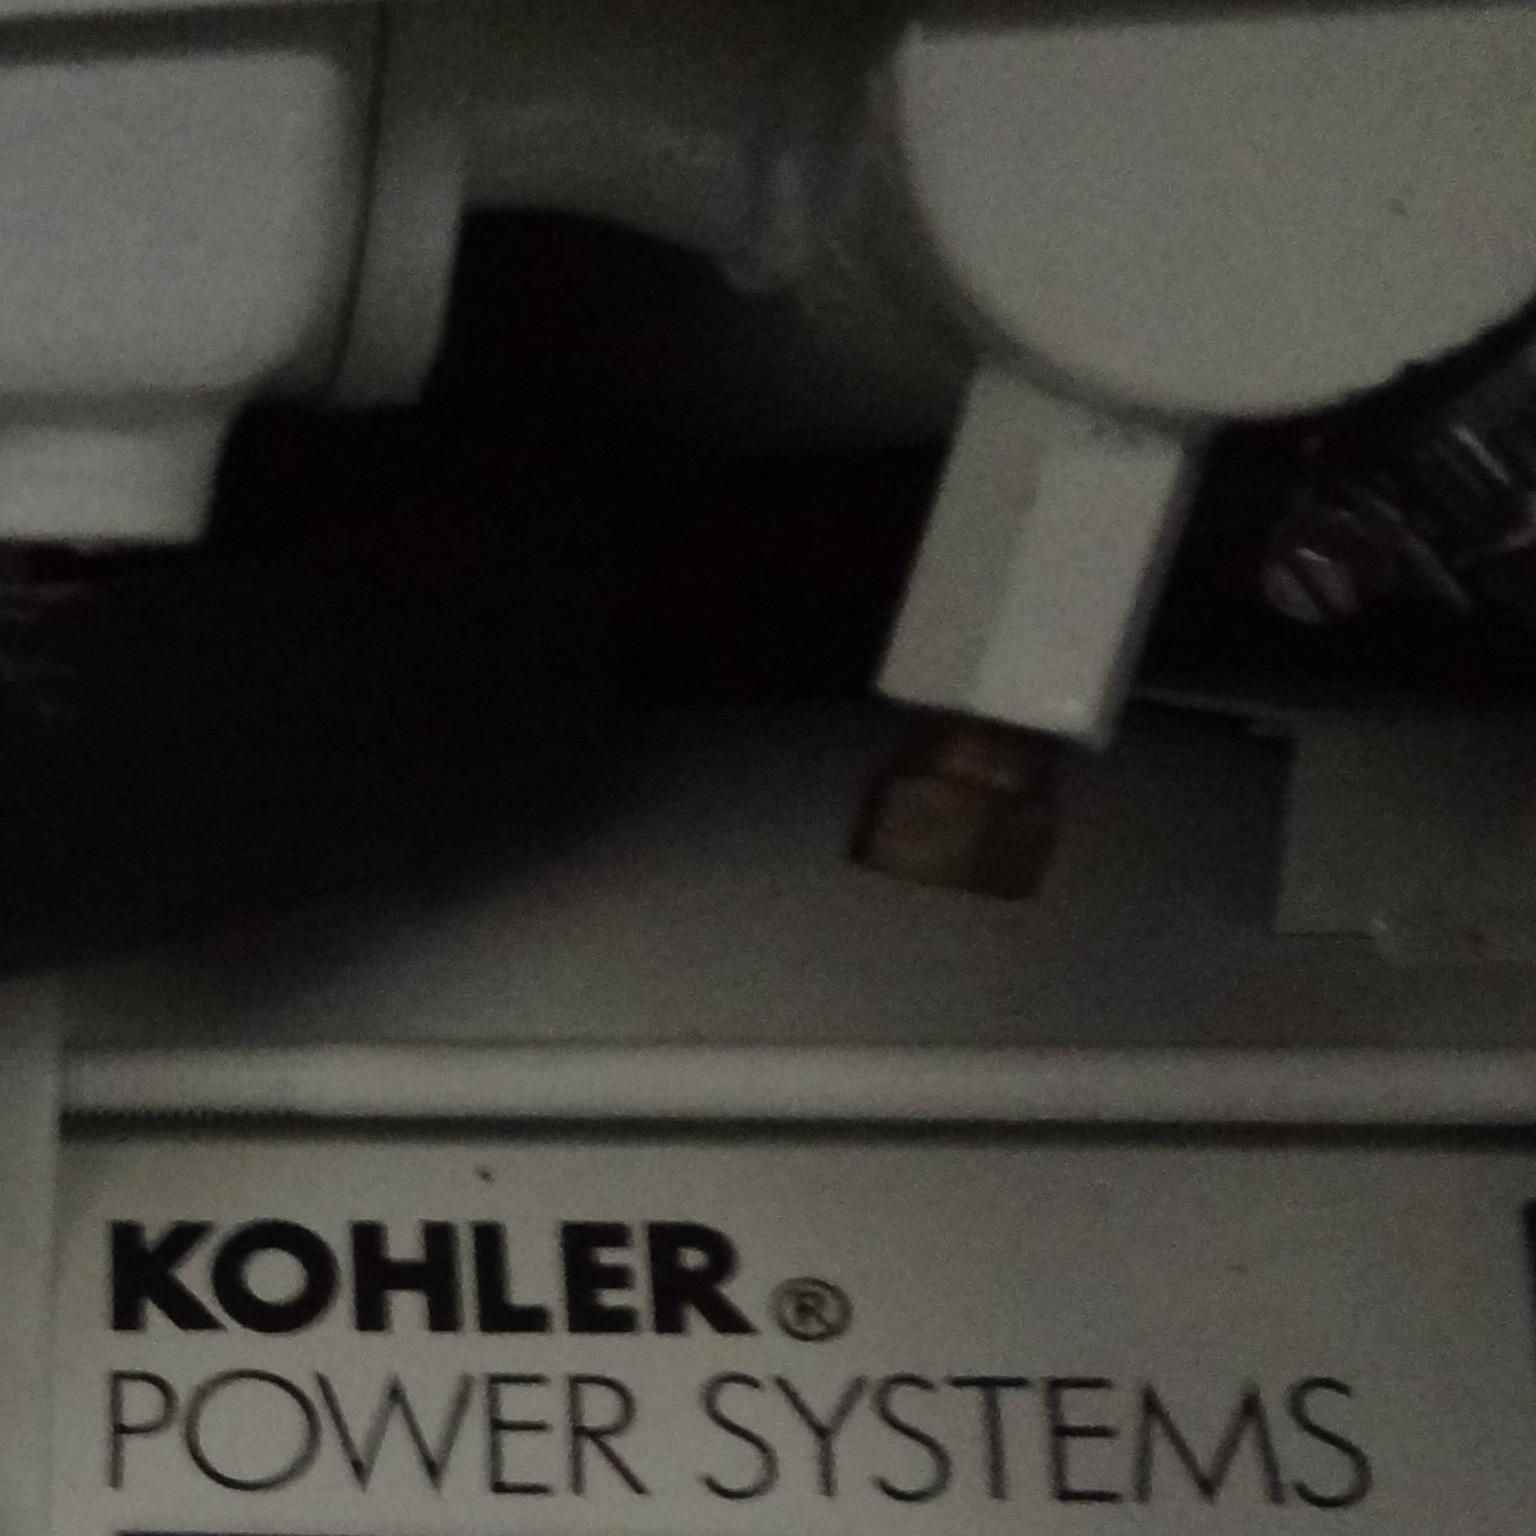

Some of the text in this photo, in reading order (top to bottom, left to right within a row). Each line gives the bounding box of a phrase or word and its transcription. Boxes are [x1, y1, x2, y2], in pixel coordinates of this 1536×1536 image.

[109, 1219, 757, 1334] KOHLER
[108, 1368, 1374, 1508] POWER SYSTEMS
